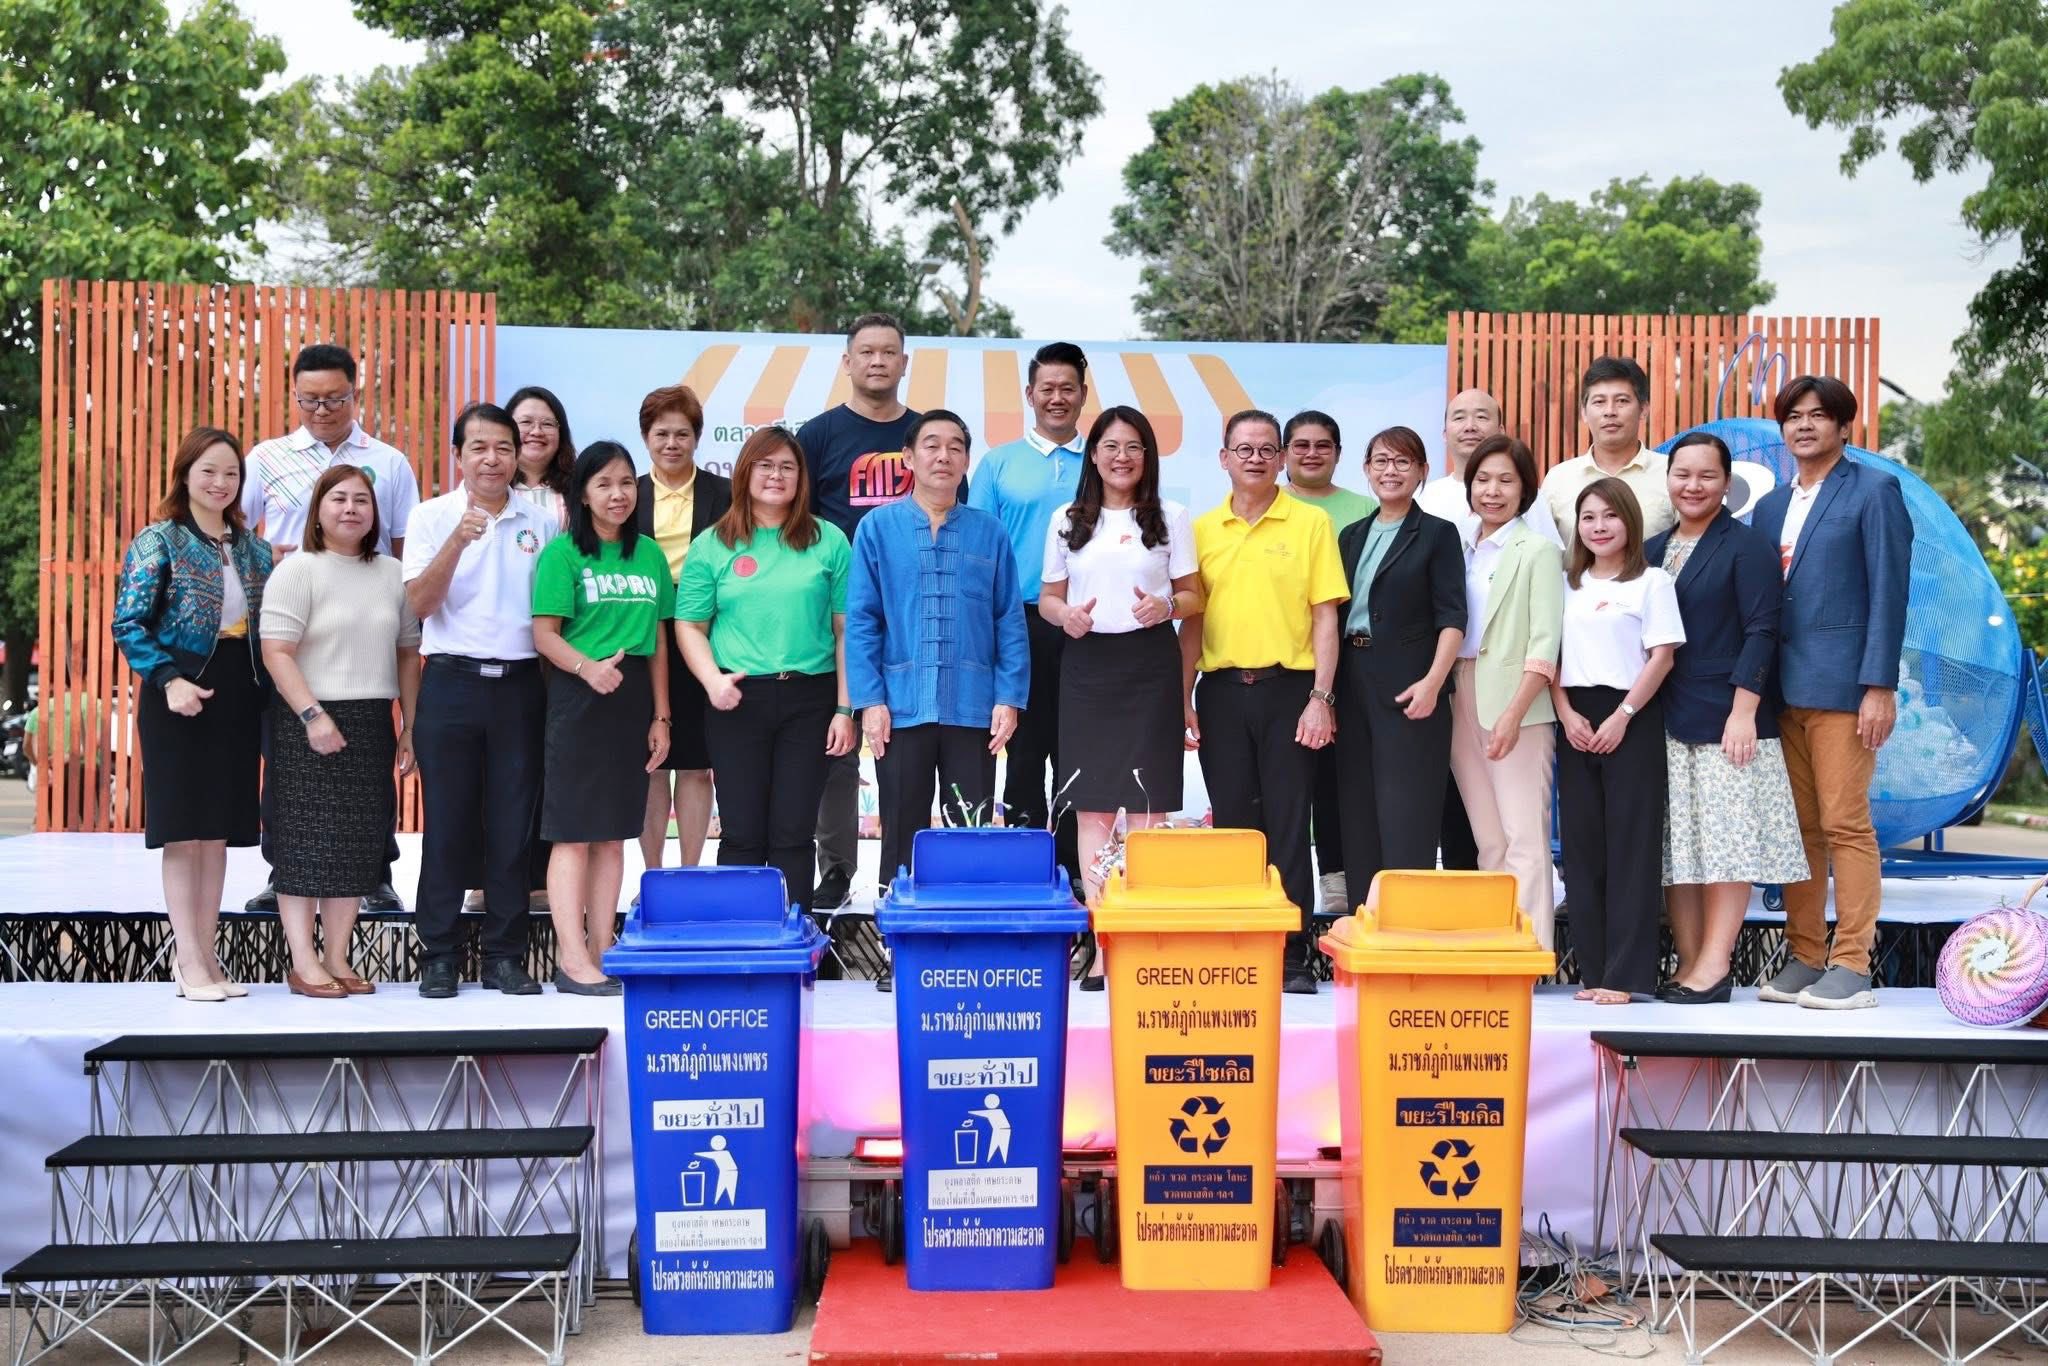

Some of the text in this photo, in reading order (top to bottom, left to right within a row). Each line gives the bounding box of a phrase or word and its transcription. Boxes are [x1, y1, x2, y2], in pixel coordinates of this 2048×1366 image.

[920, 968, 1043, 988] GREEN OFFICE
[1136, 966, 1258, 986] GREEN OFFICE
[645, 1008, 769, 1029] GREEN OFFICE
[921, 1001, 1042, 1040] ม.ราชภัฏกำแพงเพชร
[1137, 1000, 1257, 1036] ม.ราชภัฏกำแพงเพชร
[1388, 1009, 1510, 1028] GREEN OFFICE
[646, 1042, 768, 1081] ม.ราชภัฏกำแพงเพชร
[933, 1060, 1033, 1086] ขยะทั่วไป
[1149, 1057, 1250, 1082] ขยะรีไซเคิล
[1389, 1042, 1508, 1079] ม.ราชภัฏกำแพงเพชร
[658, 1101, 760, 1128] ขยะทั่วไป
[1399, 1101, 1501, 1125] ขยะรีไซเคิล
[923, 1217, 1045, 1248] โปรดช่วยกันรักษาความสะอาด
[1136, 1211, 1258, 1243] โปรดช่วยกันรักษาความสะอาด
[651, 1259, 774, 1291] โปรดช่วยกันรักษาความสะอาด
[1384, 1253, 1505, 1285] โปรดช่วยกันรักษาความสะอาด
